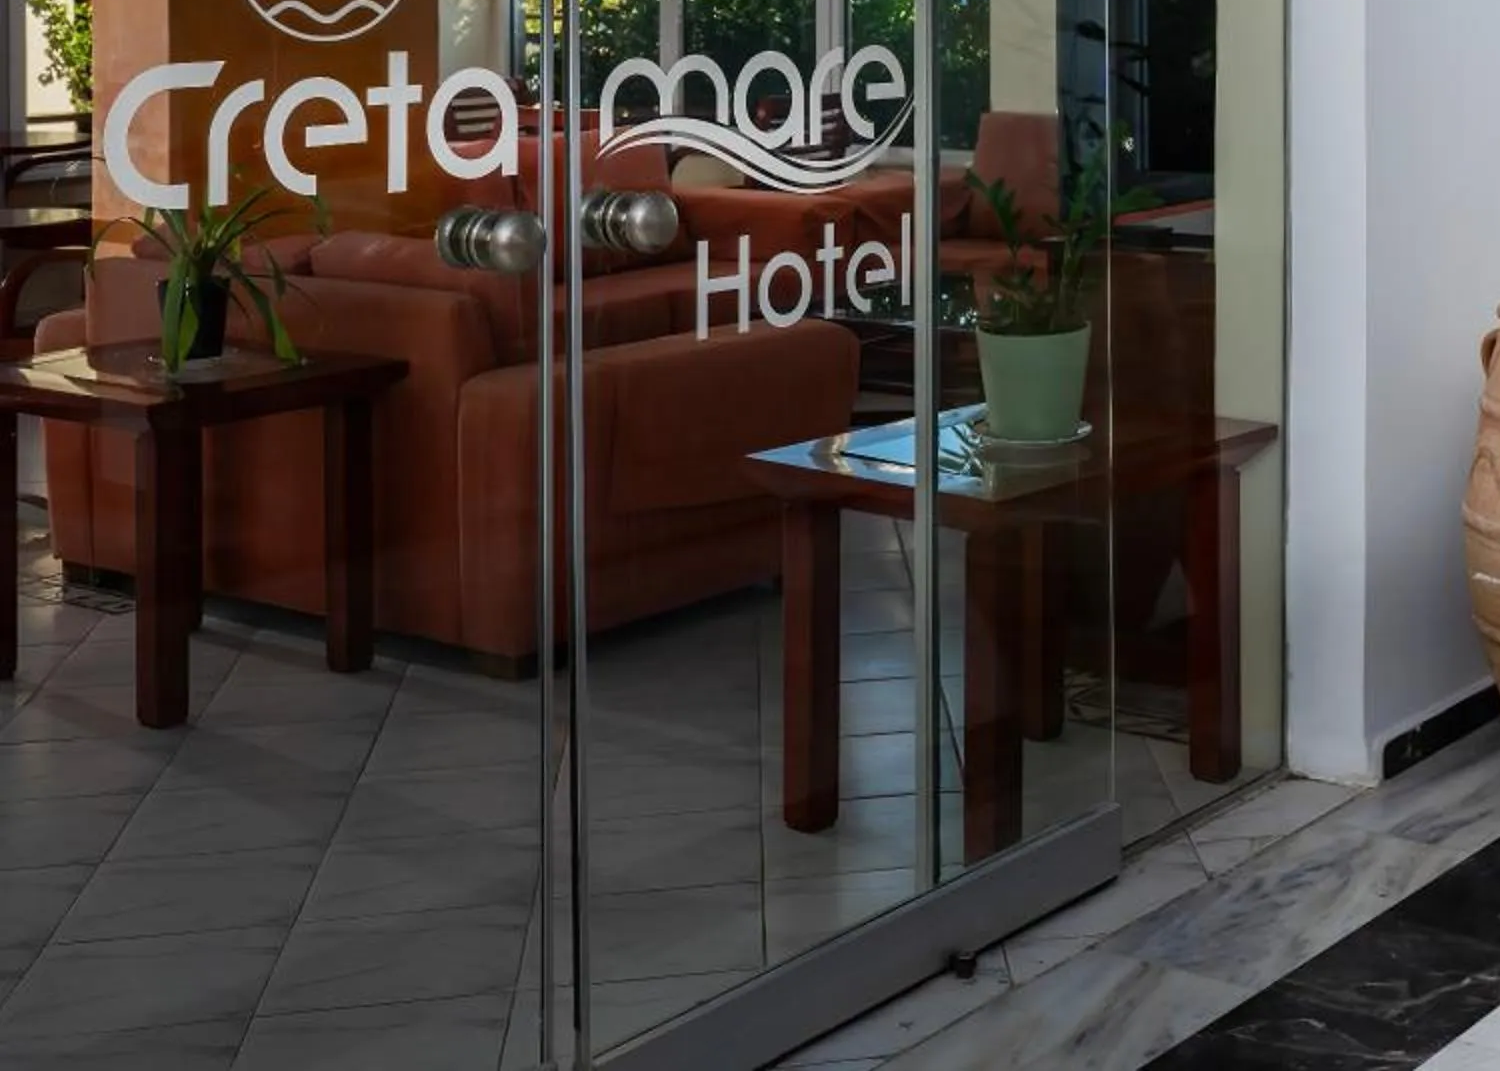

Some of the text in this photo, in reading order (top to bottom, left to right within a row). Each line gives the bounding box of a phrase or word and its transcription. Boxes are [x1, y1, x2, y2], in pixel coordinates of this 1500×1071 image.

[103, 45, 905, 210] Creta mare
[696, 212, 911, 341] Hotel
